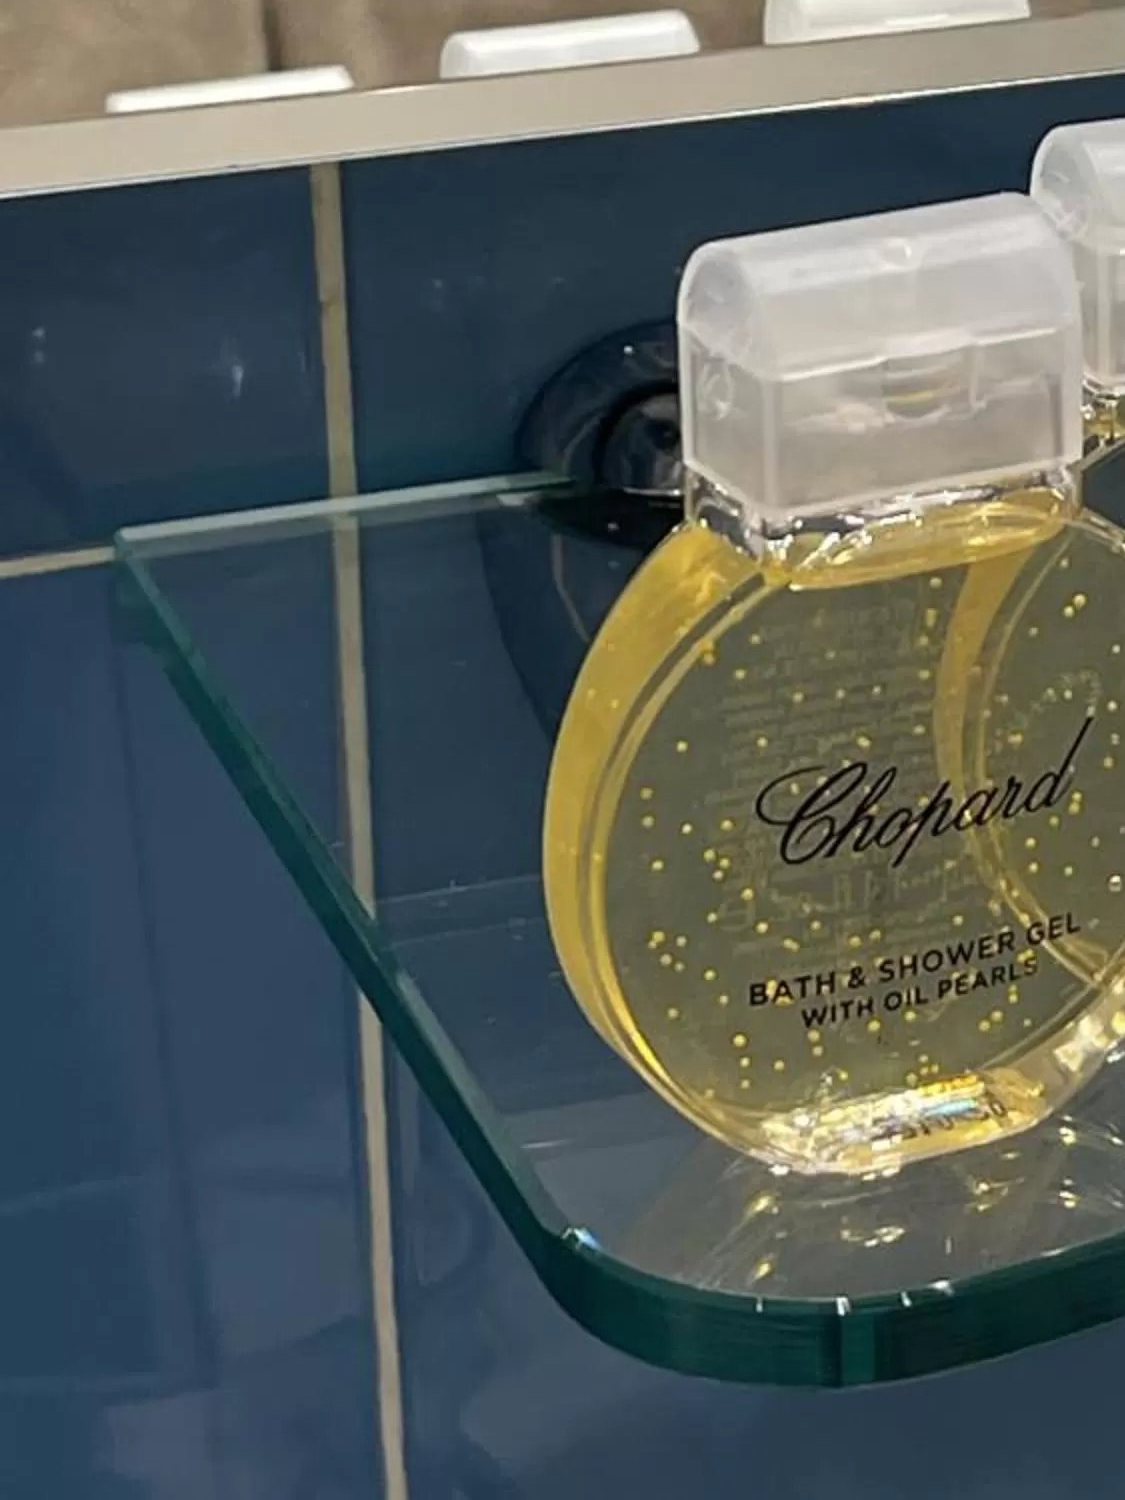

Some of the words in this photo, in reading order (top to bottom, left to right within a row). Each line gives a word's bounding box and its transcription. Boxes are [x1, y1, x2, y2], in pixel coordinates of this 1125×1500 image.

[756, 715, 1094, 868] Chopard
[749, 973, 836, 1007] BATH
[849, 965, 867, 988] &
[878, 931, 1016, 983] SHOWER
[1026, 912, 1082, 946] GEL
[801, 996, 875, 1028] WITH
[883, 986, 929, 1013] OIL
[938, 955, 1038, 1000] PEARLS
